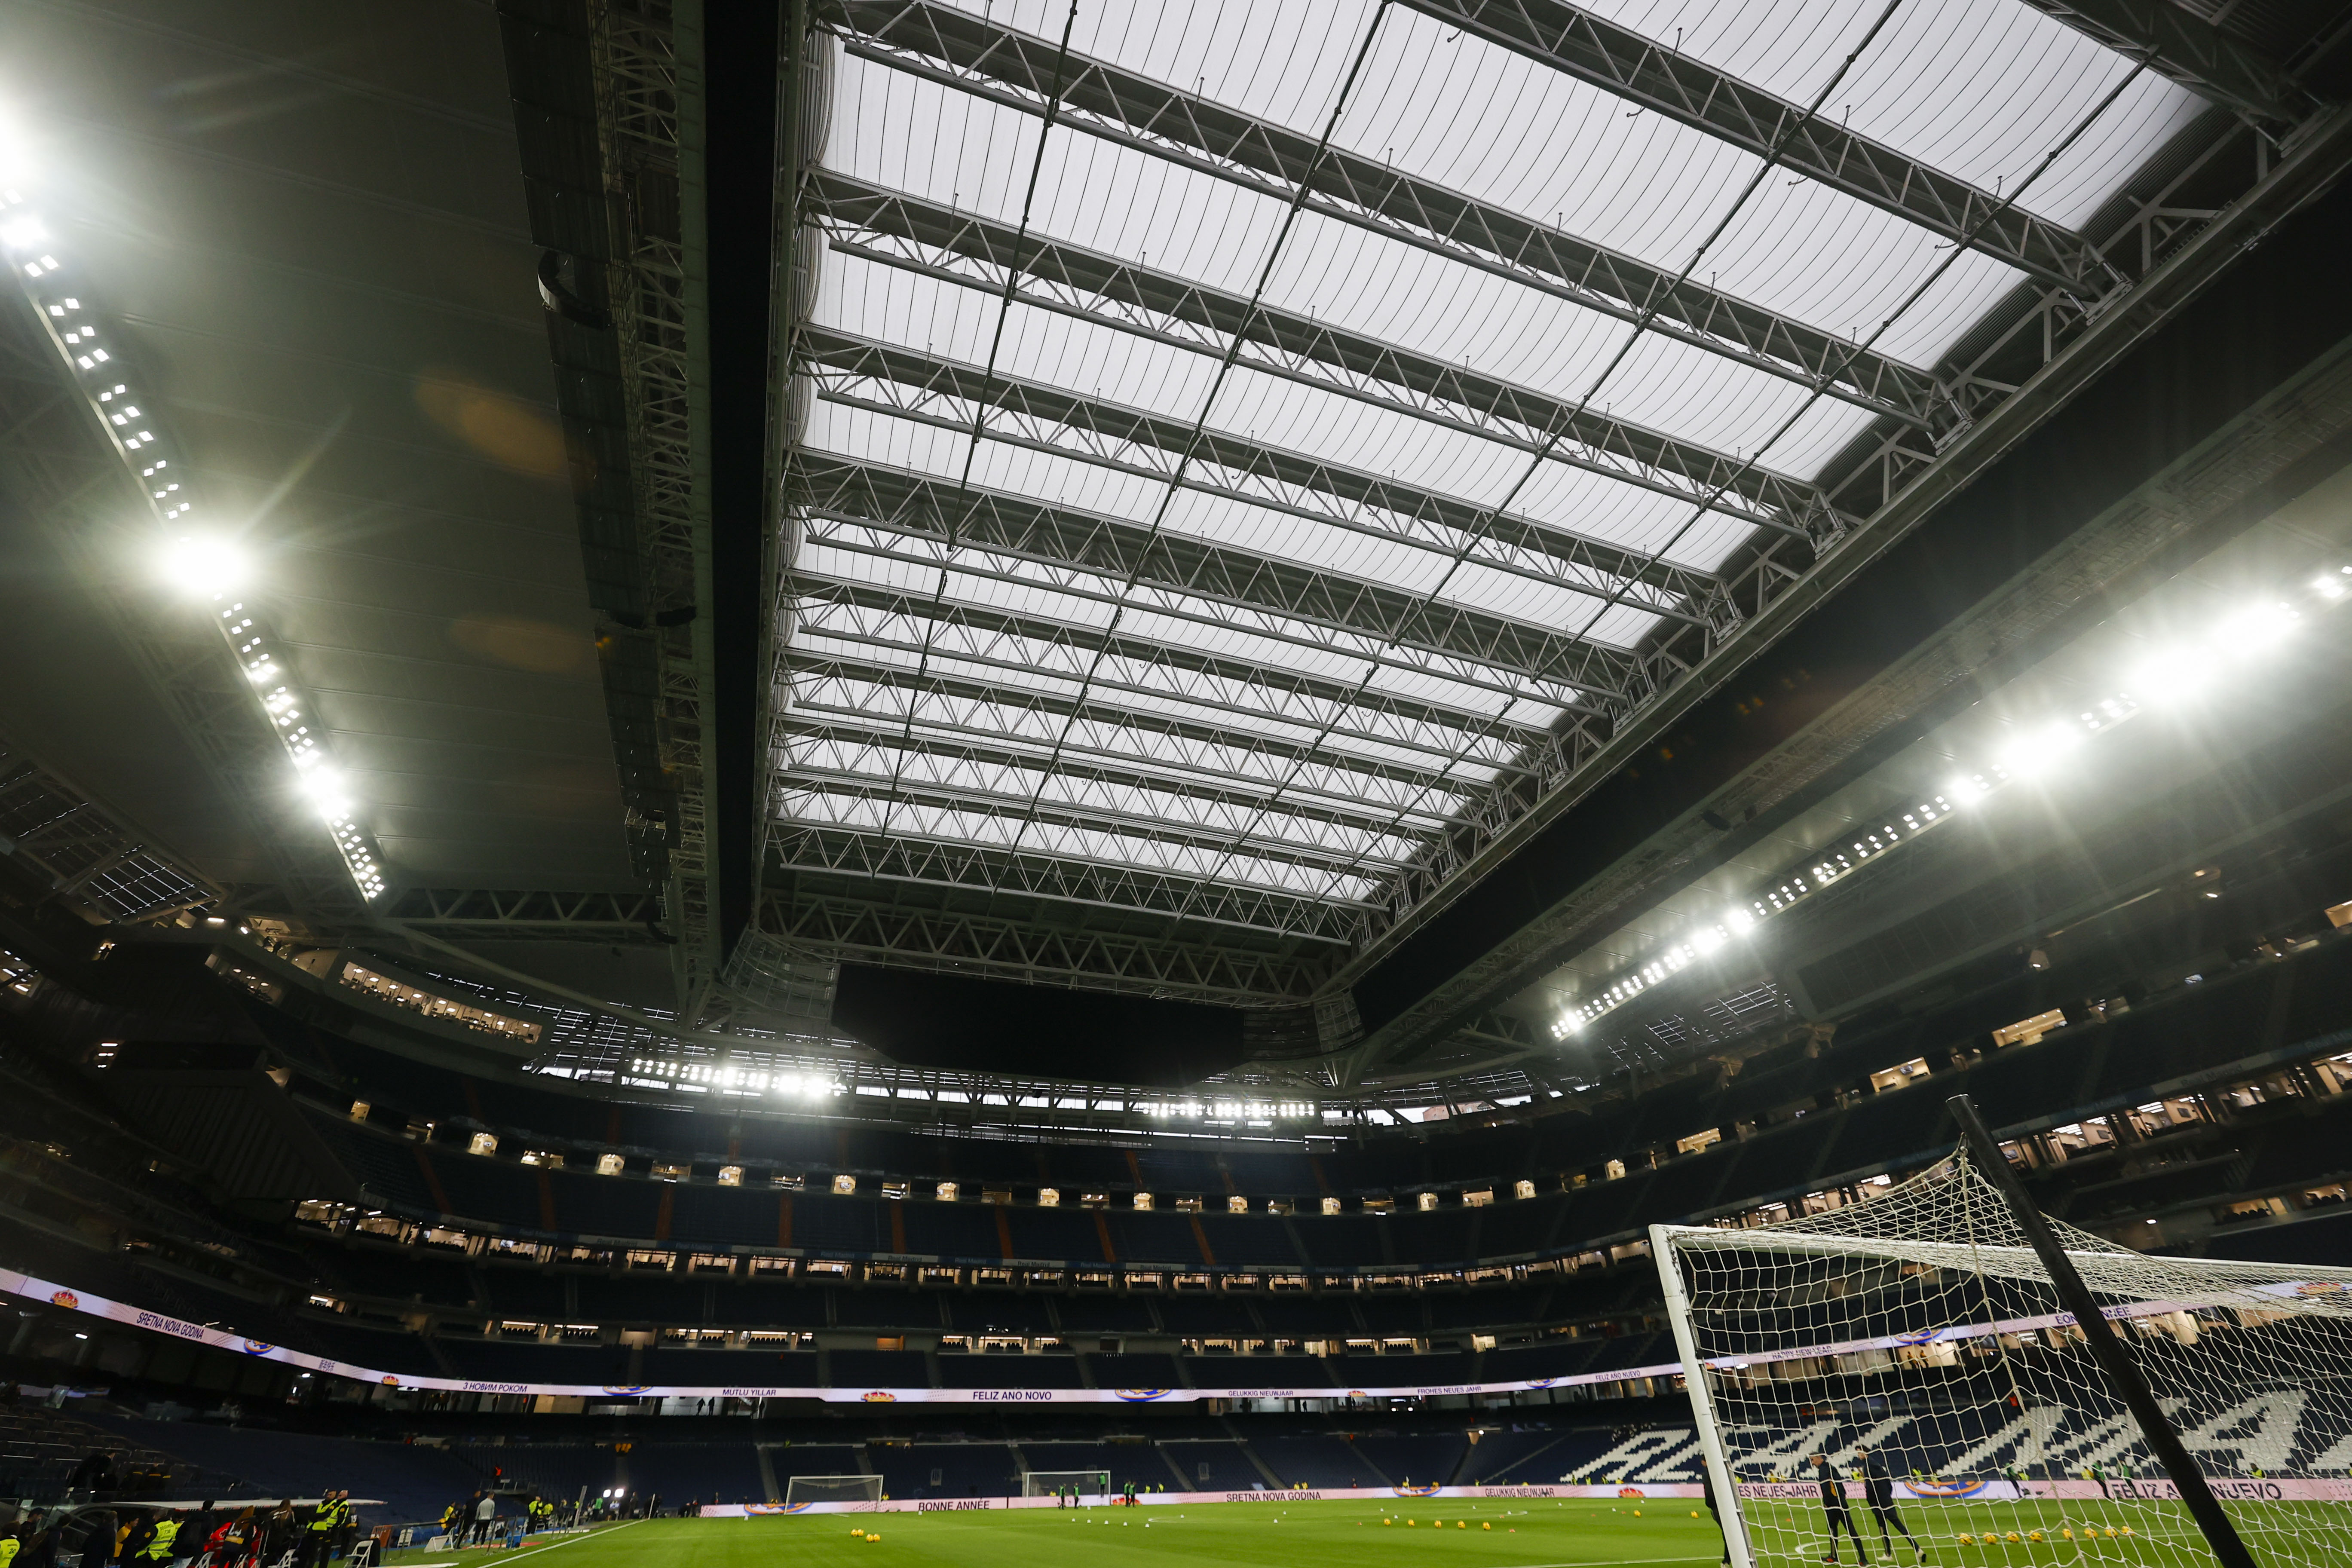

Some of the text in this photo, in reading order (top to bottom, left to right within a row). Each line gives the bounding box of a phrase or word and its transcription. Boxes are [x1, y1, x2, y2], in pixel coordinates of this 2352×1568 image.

[136, 1312, 204, 1340] SRETNA NOVA GODINA
[1623, 1370, 1641, 1378] NUEVO
[469, 1383, 497, 1391] НОВИМ
[498, 1384, 527, 1392] РОКОМ
[973, 1391, 1052, 1400] FELIZ ANO NOVO
[1485, 1488, 1555, 1497] GELUKKIG NIEUWJAAR
[1753, 1486, 1786, 1498] NEUES
[1791, 1485, 1819, 1498] JAHR
[2210, 1483, 2283, 1500] NUEVO
[1227, 1492, 1321, 1502] SRETNA NOVA GODINA
[919, 1497, 989, 1511] BONNE ANNÉE
